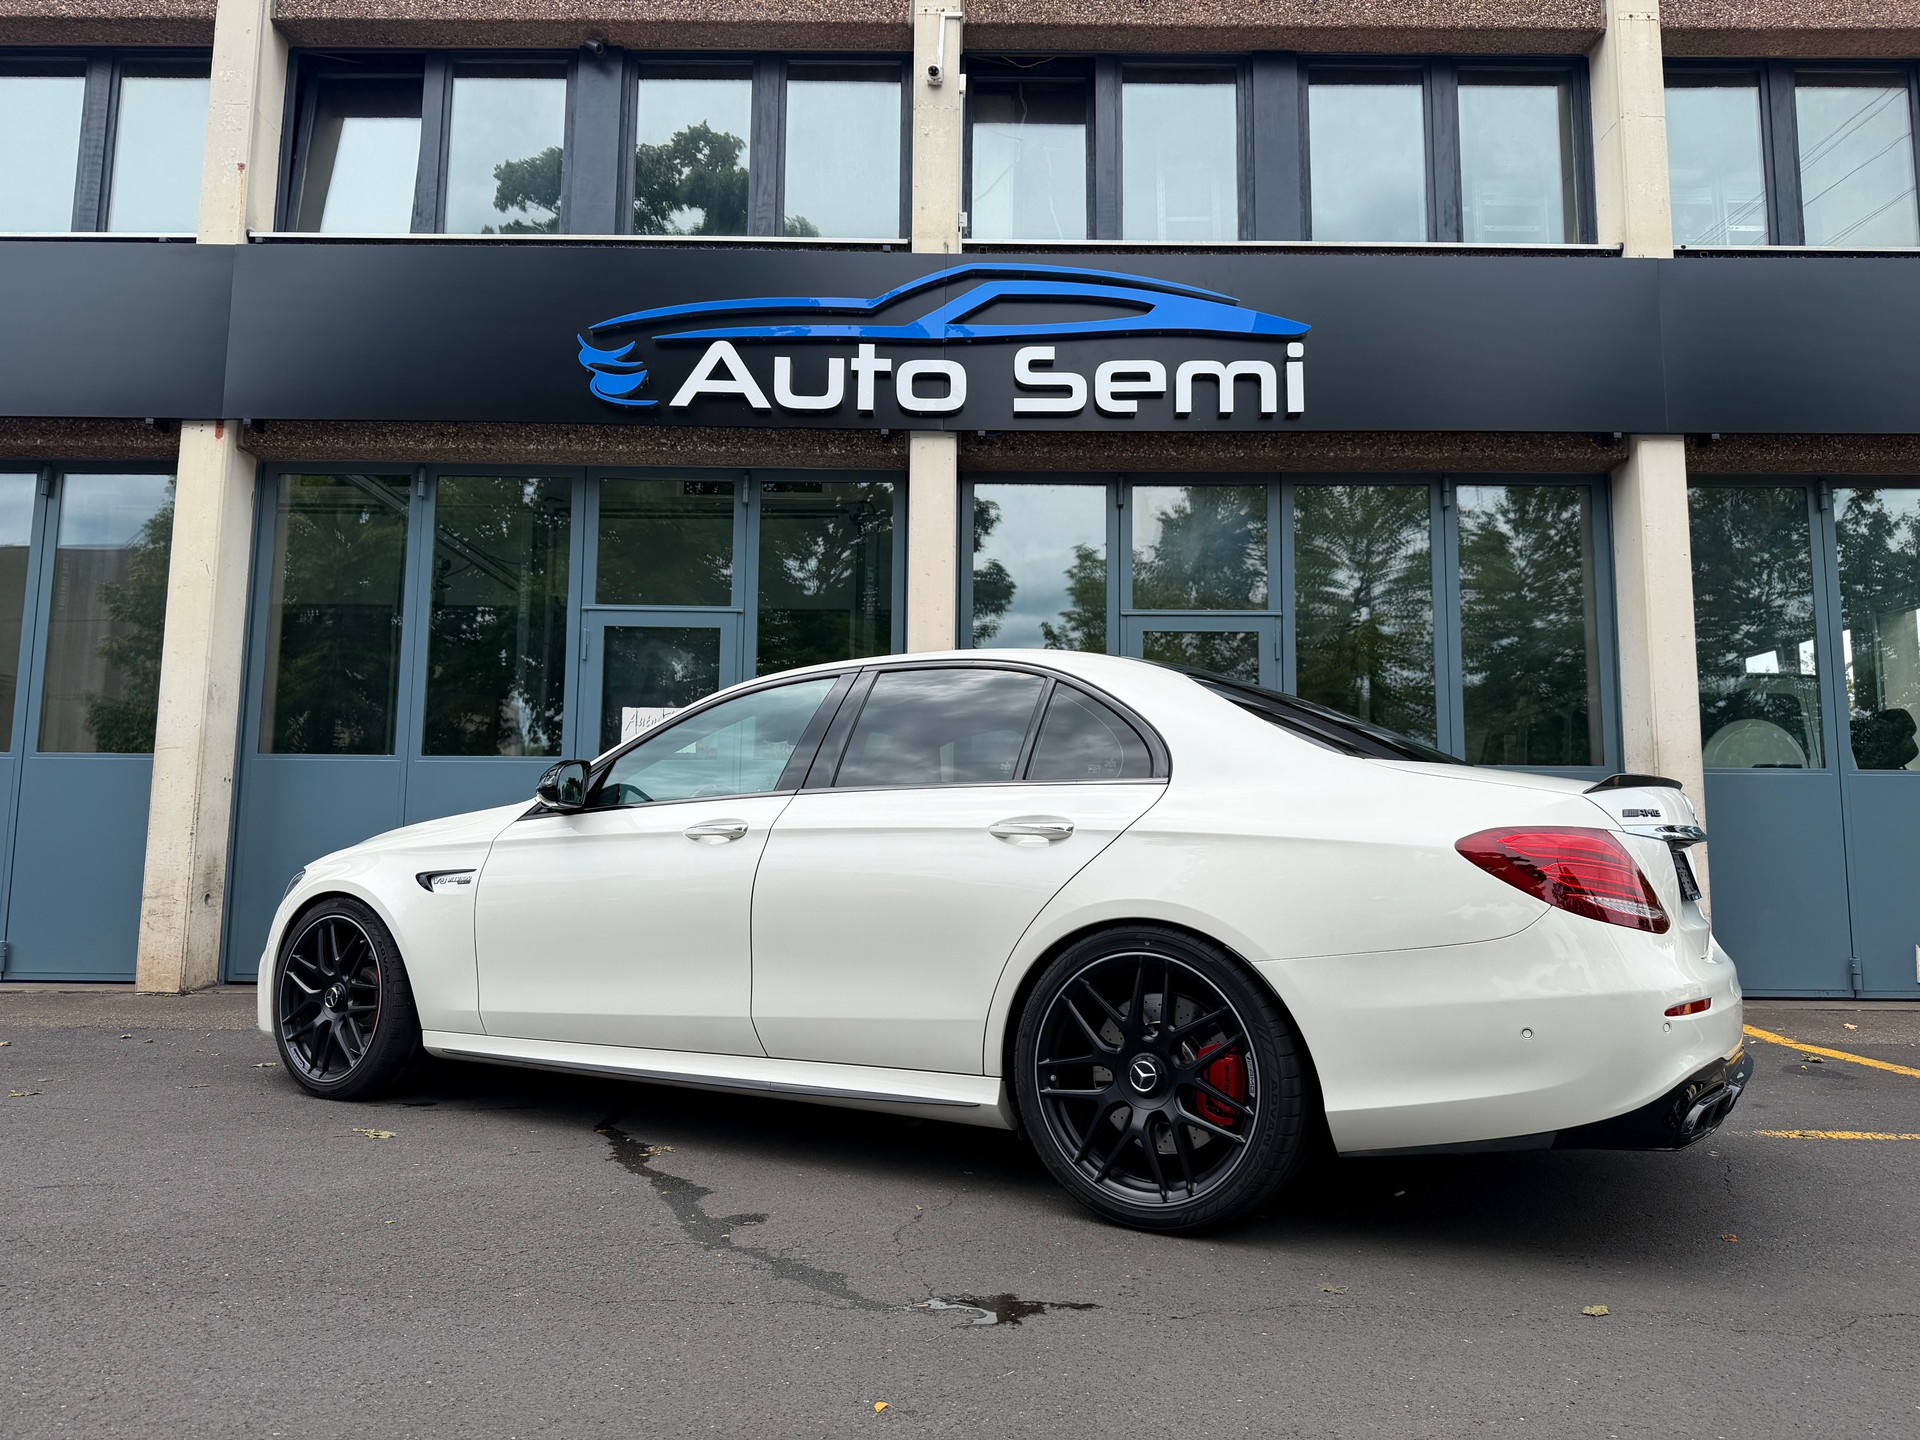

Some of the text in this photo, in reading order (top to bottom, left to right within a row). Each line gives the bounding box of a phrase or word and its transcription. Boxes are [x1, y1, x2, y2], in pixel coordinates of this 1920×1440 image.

[668, 340, 1306, 415] Auto Semi
[377, 940, 390, 984] ADVAN
[1262, 1079, 1278, 1147] ADVAN
